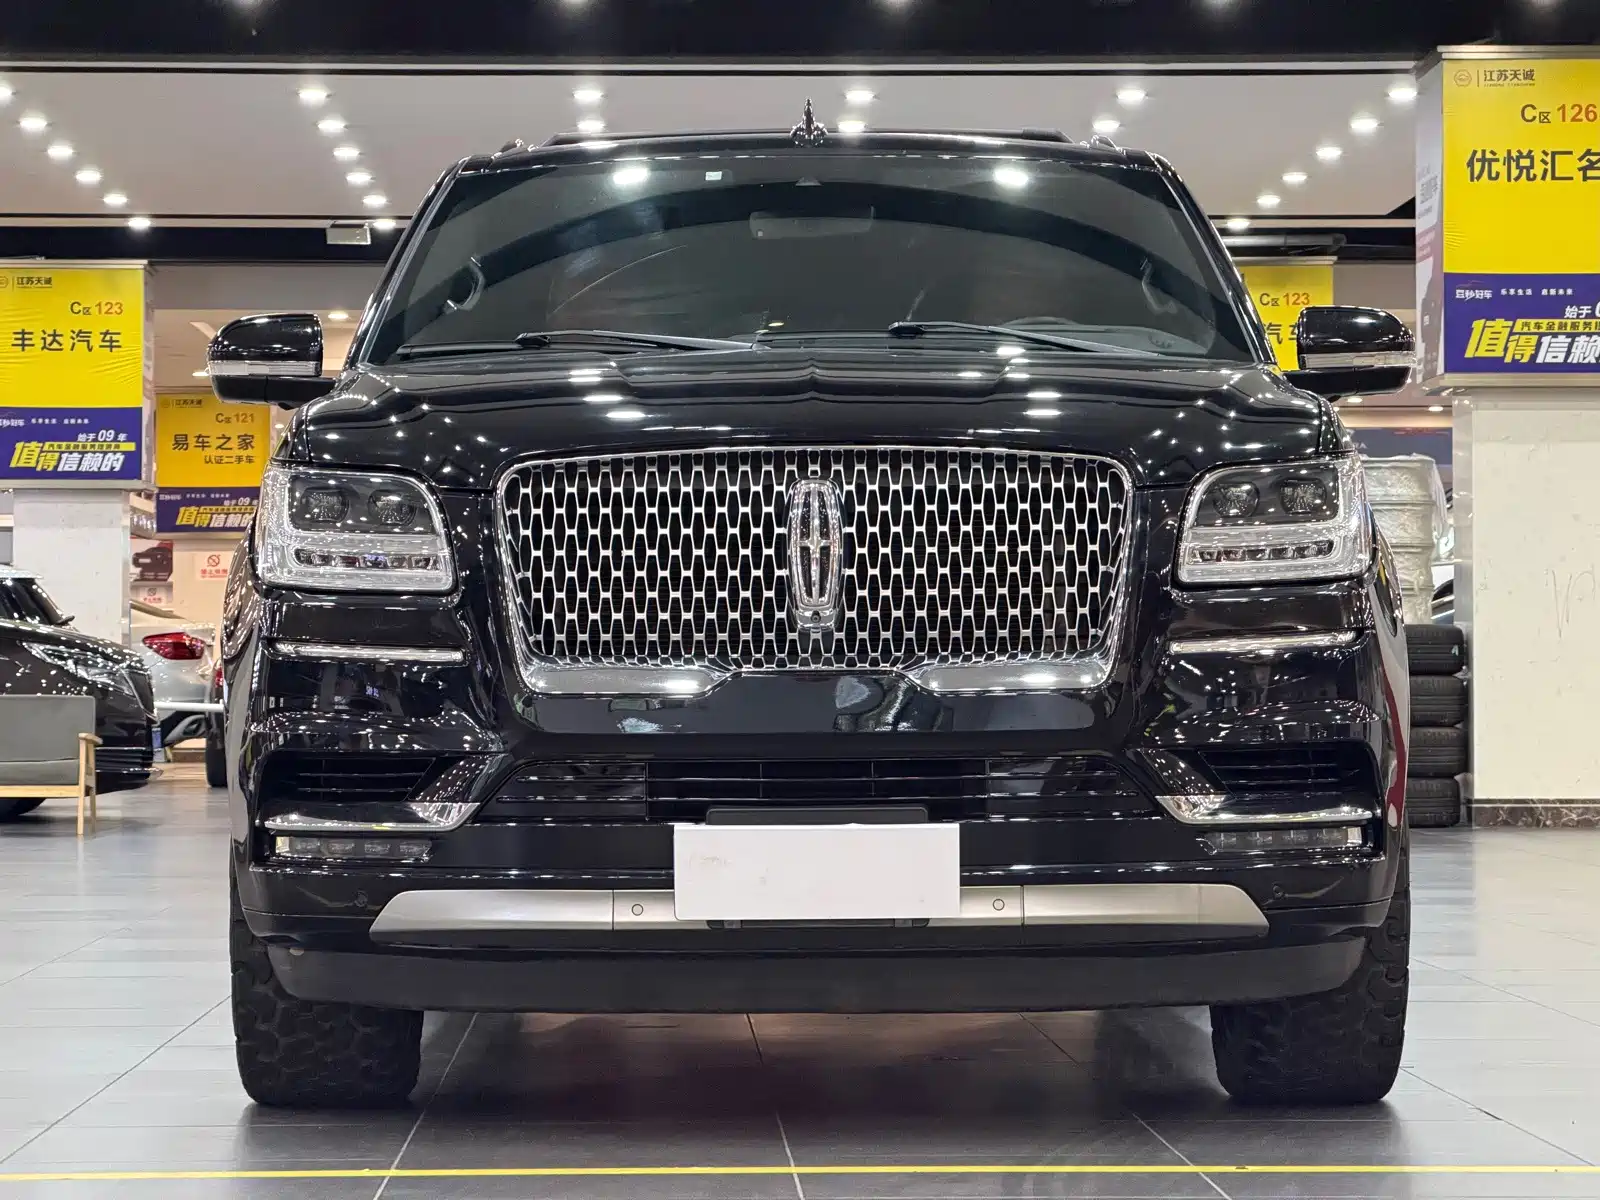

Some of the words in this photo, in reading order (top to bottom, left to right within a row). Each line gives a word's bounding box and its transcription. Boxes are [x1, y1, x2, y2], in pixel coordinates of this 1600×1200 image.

[1484, 69, 1535, 81] 江苏天诚
[1557, 103, 1597, 122] 126
[1466, 149, 1600, 182] 优悦汇名
[1283, 292, 1310, 305] 123
[95, 301, 123, 314] 123
[11, 328, 122, 352] 丰达汽车
[172, 434, 255, 451] 易车之家
[9, 441, 125, 472] 值得信赖的
[204, 454, 255, 464] 认证二手车
